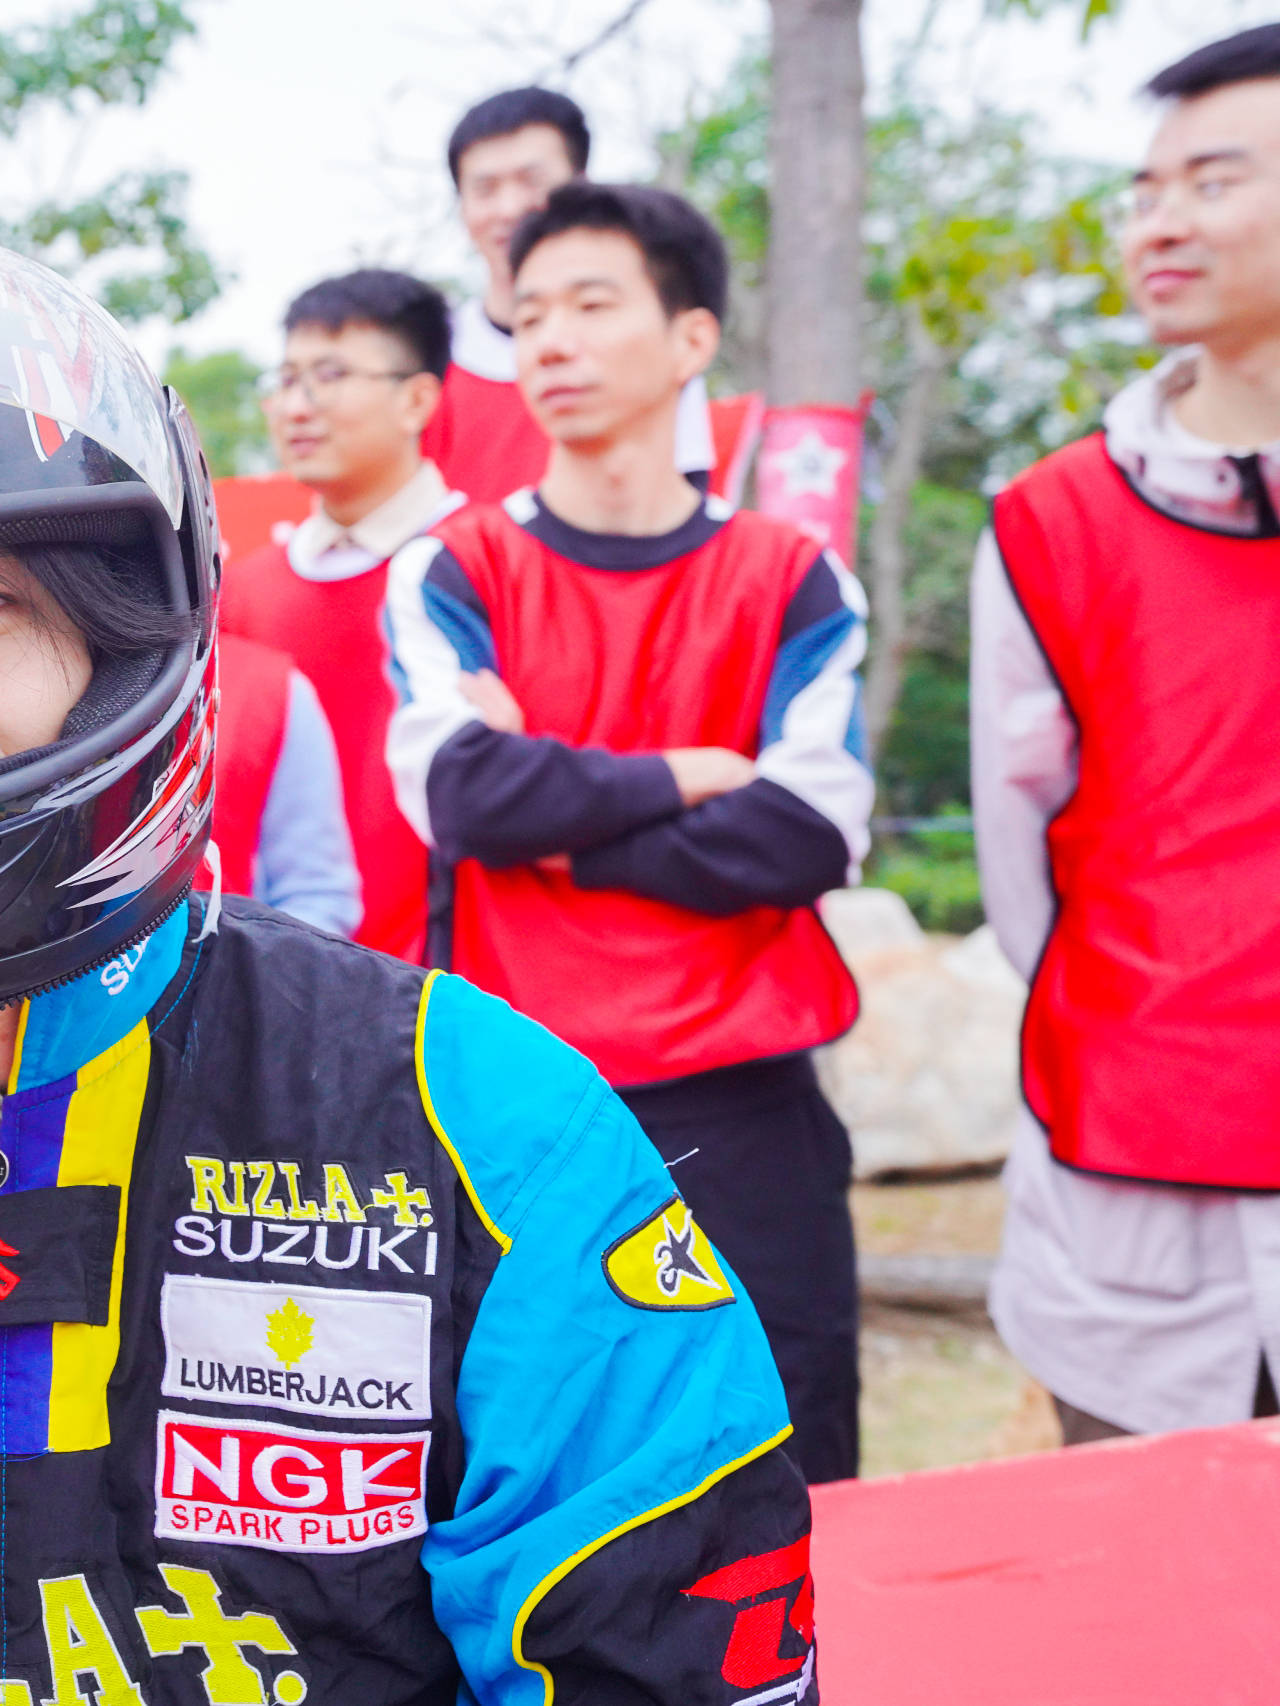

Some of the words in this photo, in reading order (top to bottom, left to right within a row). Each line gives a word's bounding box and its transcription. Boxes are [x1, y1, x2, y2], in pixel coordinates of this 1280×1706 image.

[173, 1215, 438, 1276] SUZUKI
[180, 1358, 414, 1410] LUMBERJACK
[172, 1430, 416, 1511] NGK
[171, 1504, 283, 1542] SPARK
[301, 1505, 415, 1544] PLUGS
